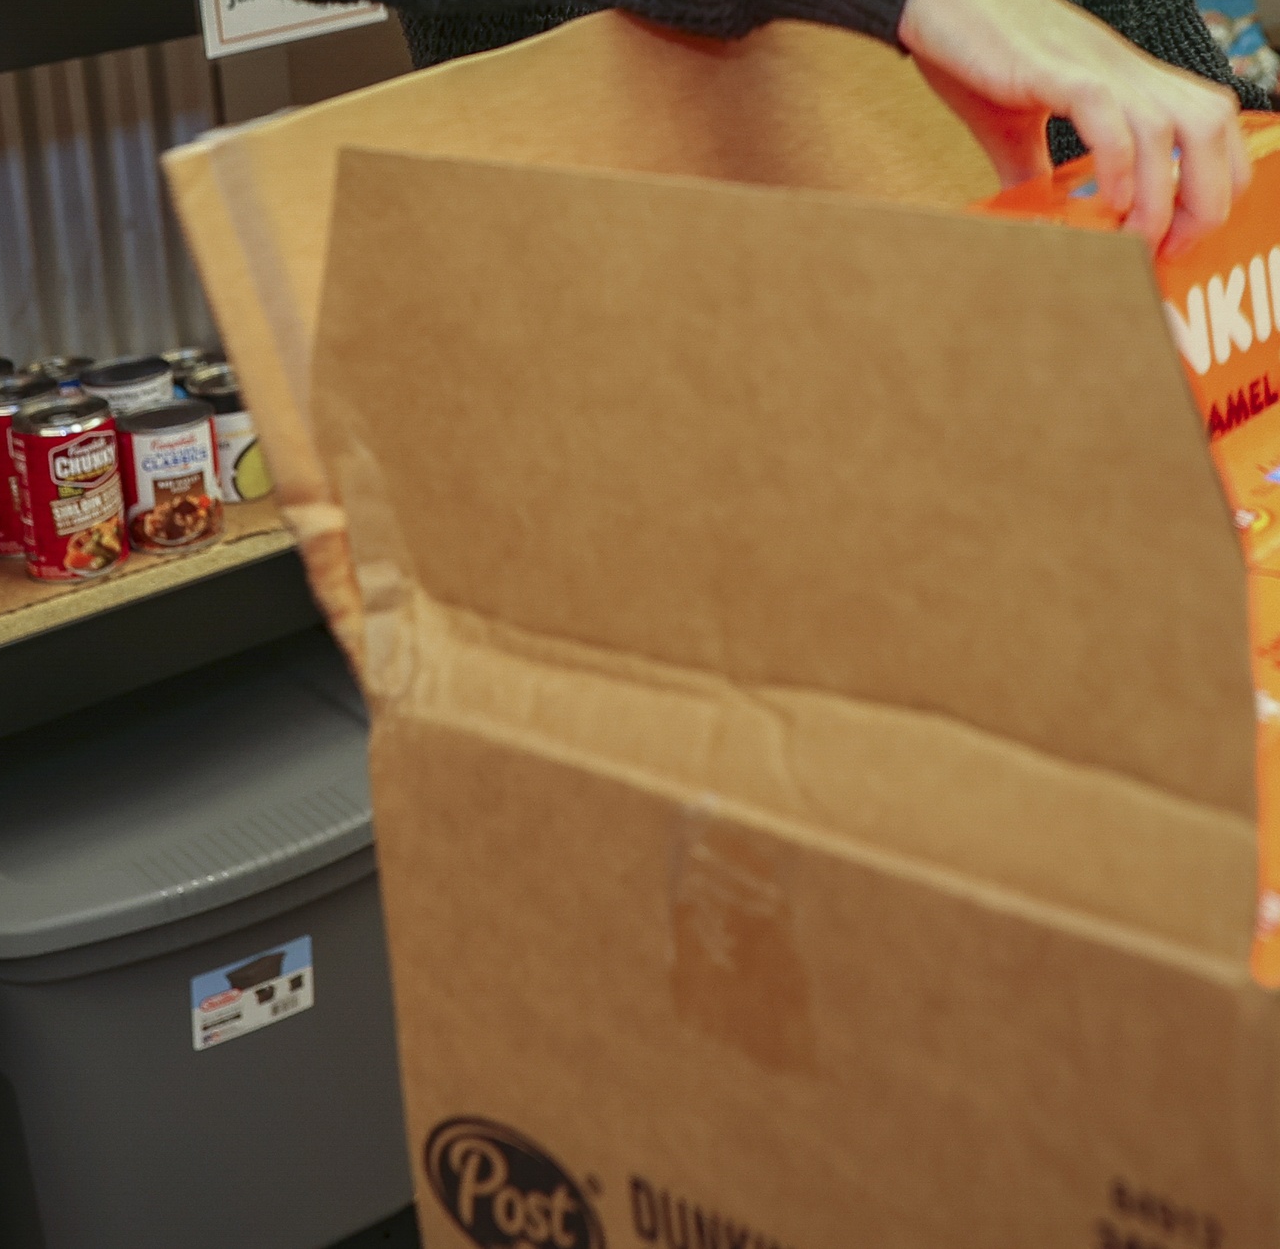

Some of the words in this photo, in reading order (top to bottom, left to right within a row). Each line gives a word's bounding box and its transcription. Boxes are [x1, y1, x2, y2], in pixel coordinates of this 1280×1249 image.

[1210, 369, 1279, 435] AMEL
[55, 443, 114, 480] CHUNKY
[448, 1136, 580, 1249] Post
[628, 1173, 796, 1249] DUNK
